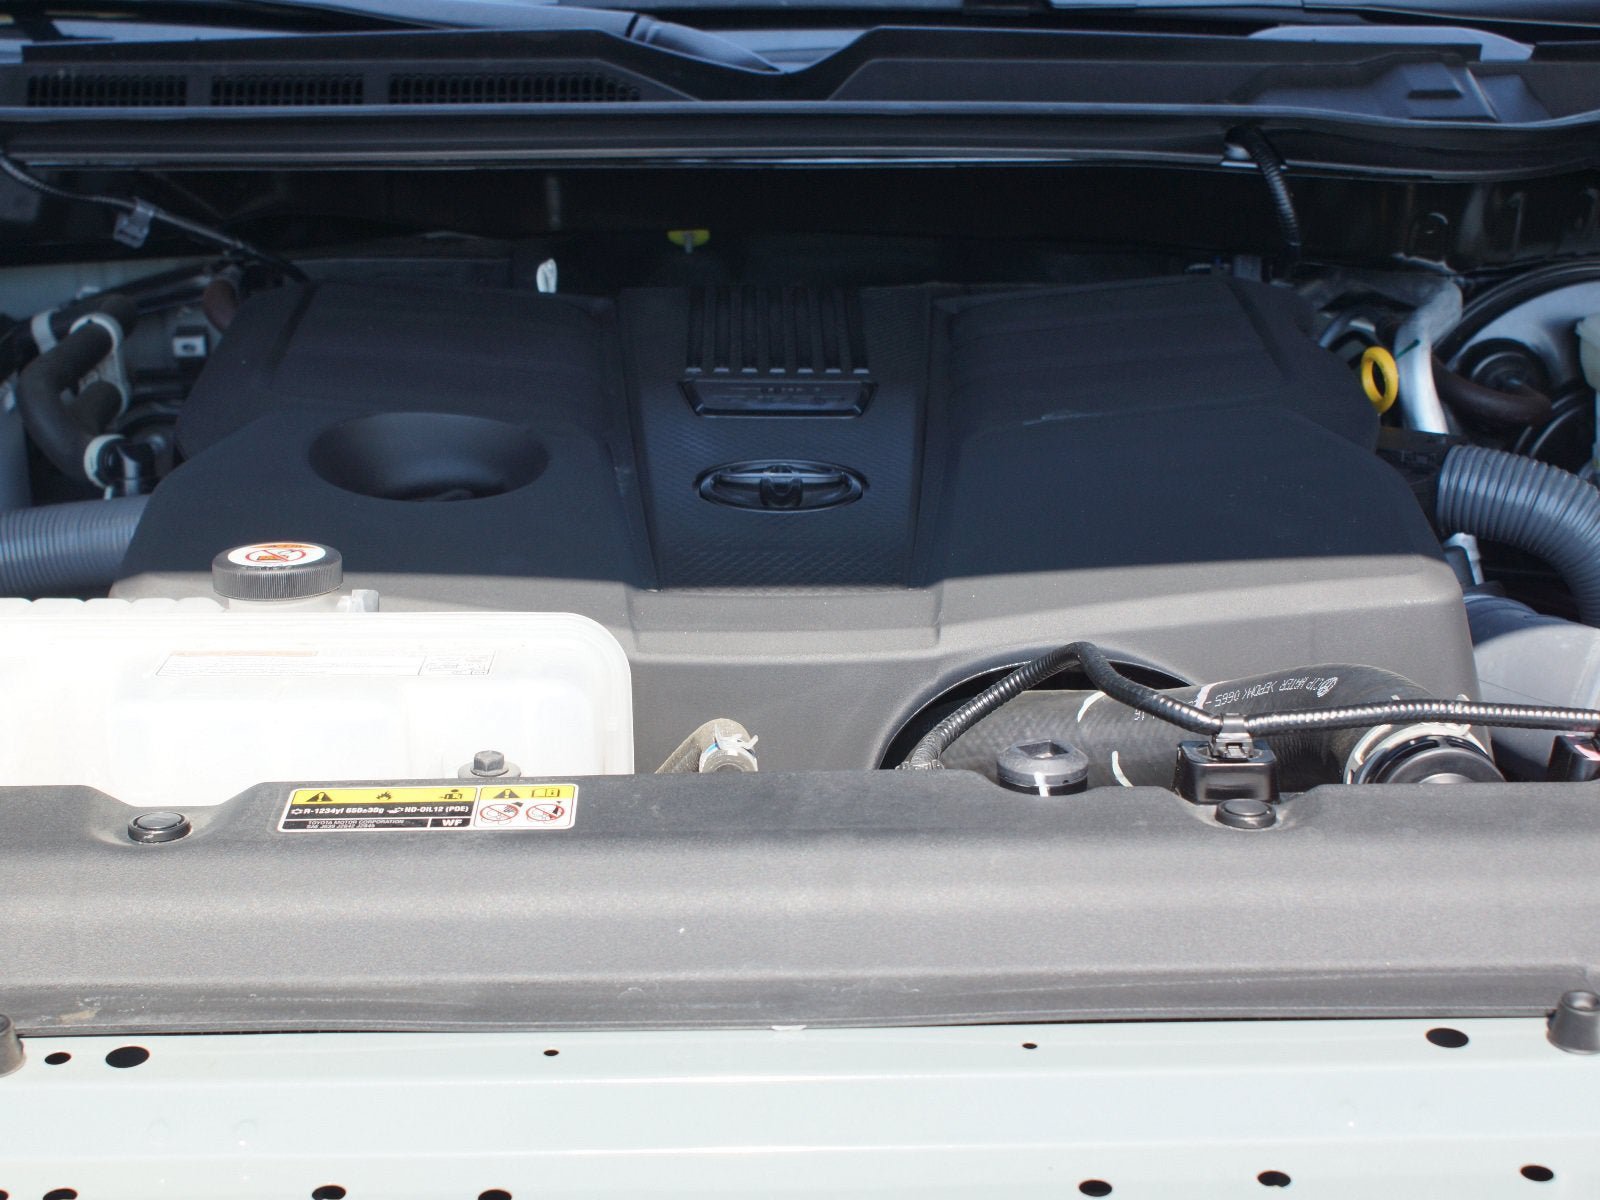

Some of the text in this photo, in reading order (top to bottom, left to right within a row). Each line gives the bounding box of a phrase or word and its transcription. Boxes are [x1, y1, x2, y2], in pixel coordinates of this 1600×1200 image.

[1279, 676, 1309, 691] WATER
[303, 807, 345, 815] R-1234yf
[445, 805, 469, 813] (POE)
[442, 819, 463, 827] WF
